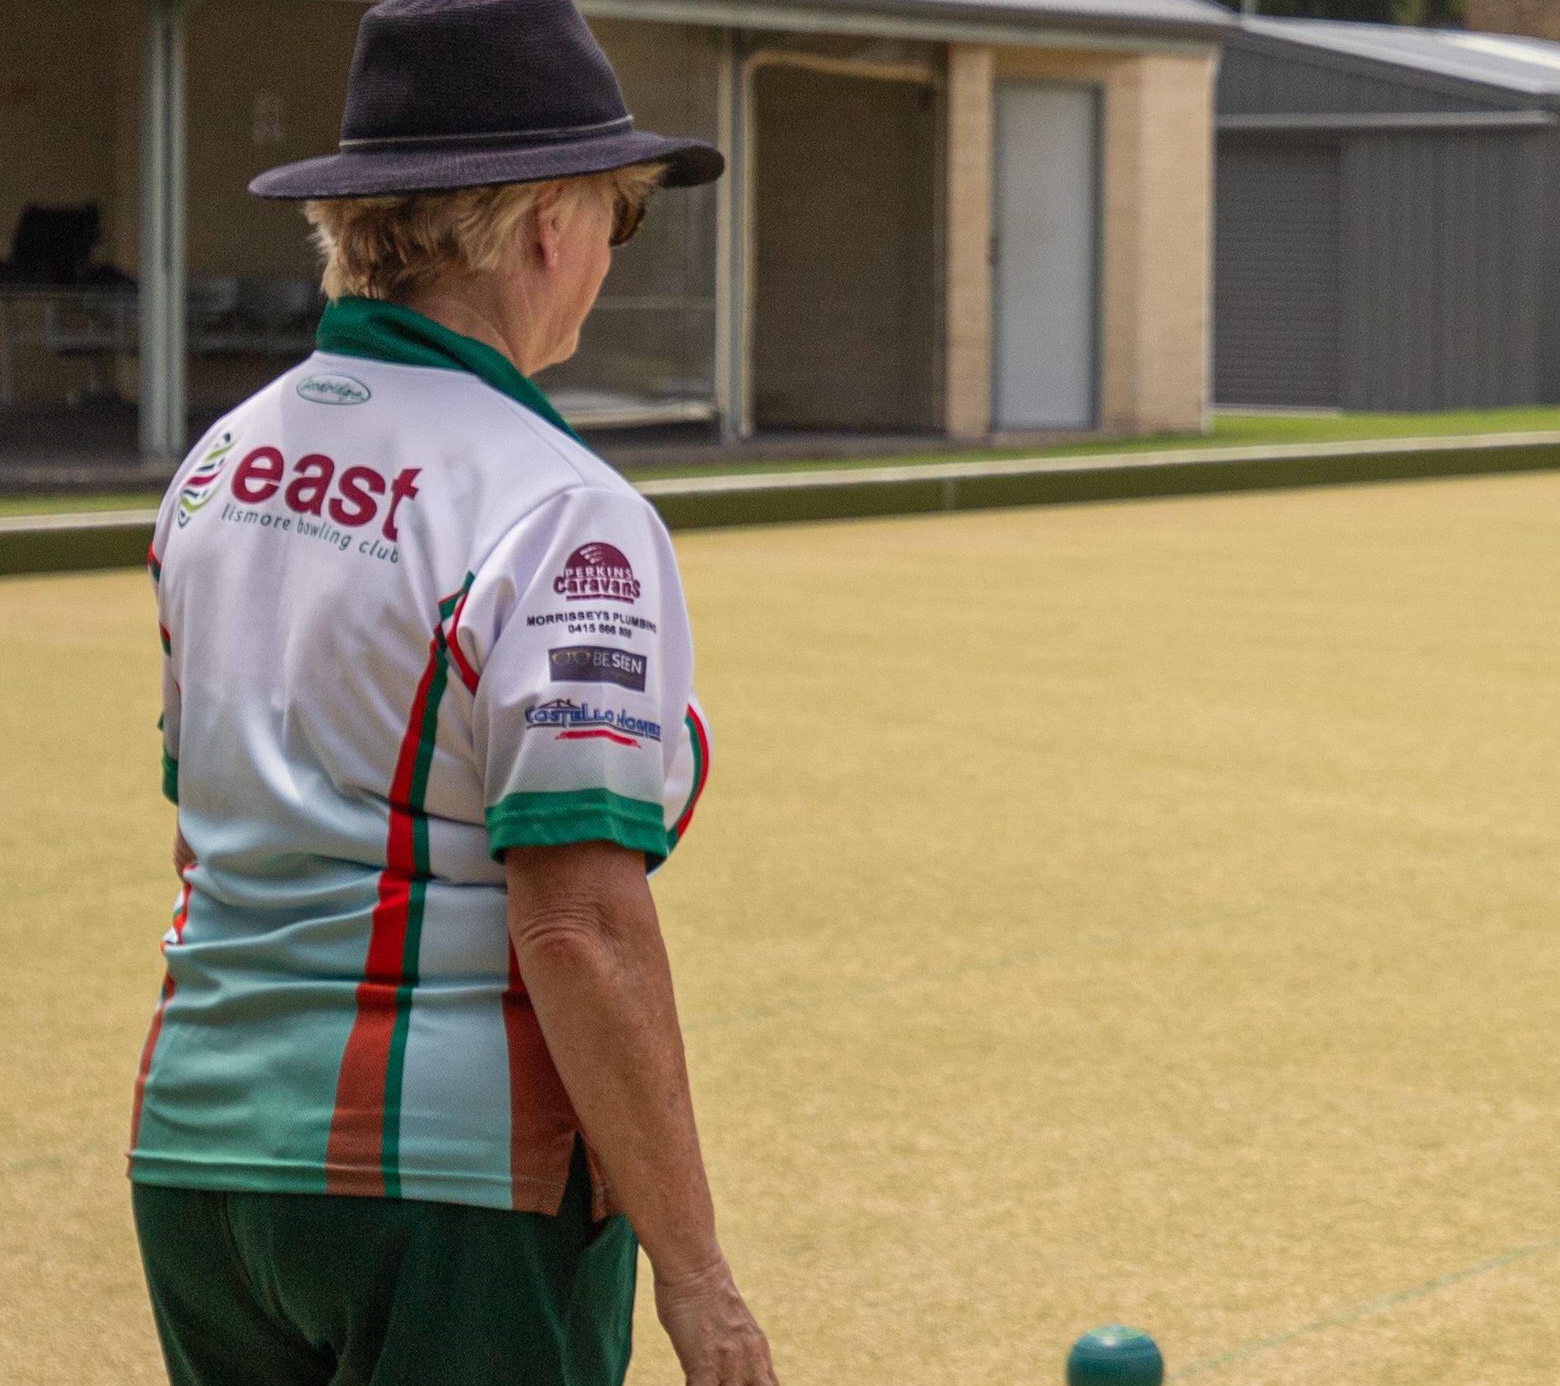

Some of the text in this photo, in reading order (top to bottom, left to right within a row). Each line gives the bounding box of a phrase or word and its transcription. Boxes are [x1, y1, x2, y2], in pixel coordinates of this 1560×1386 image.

[230, 445, 423, 543] east
[221, 503, 400, 564] lismore bowling club
[565, 566, 632, 579] PERKINS
[526, 610, 610, 627] MORRISSEYS
[593, 650, 642, 675] BE SEEN
